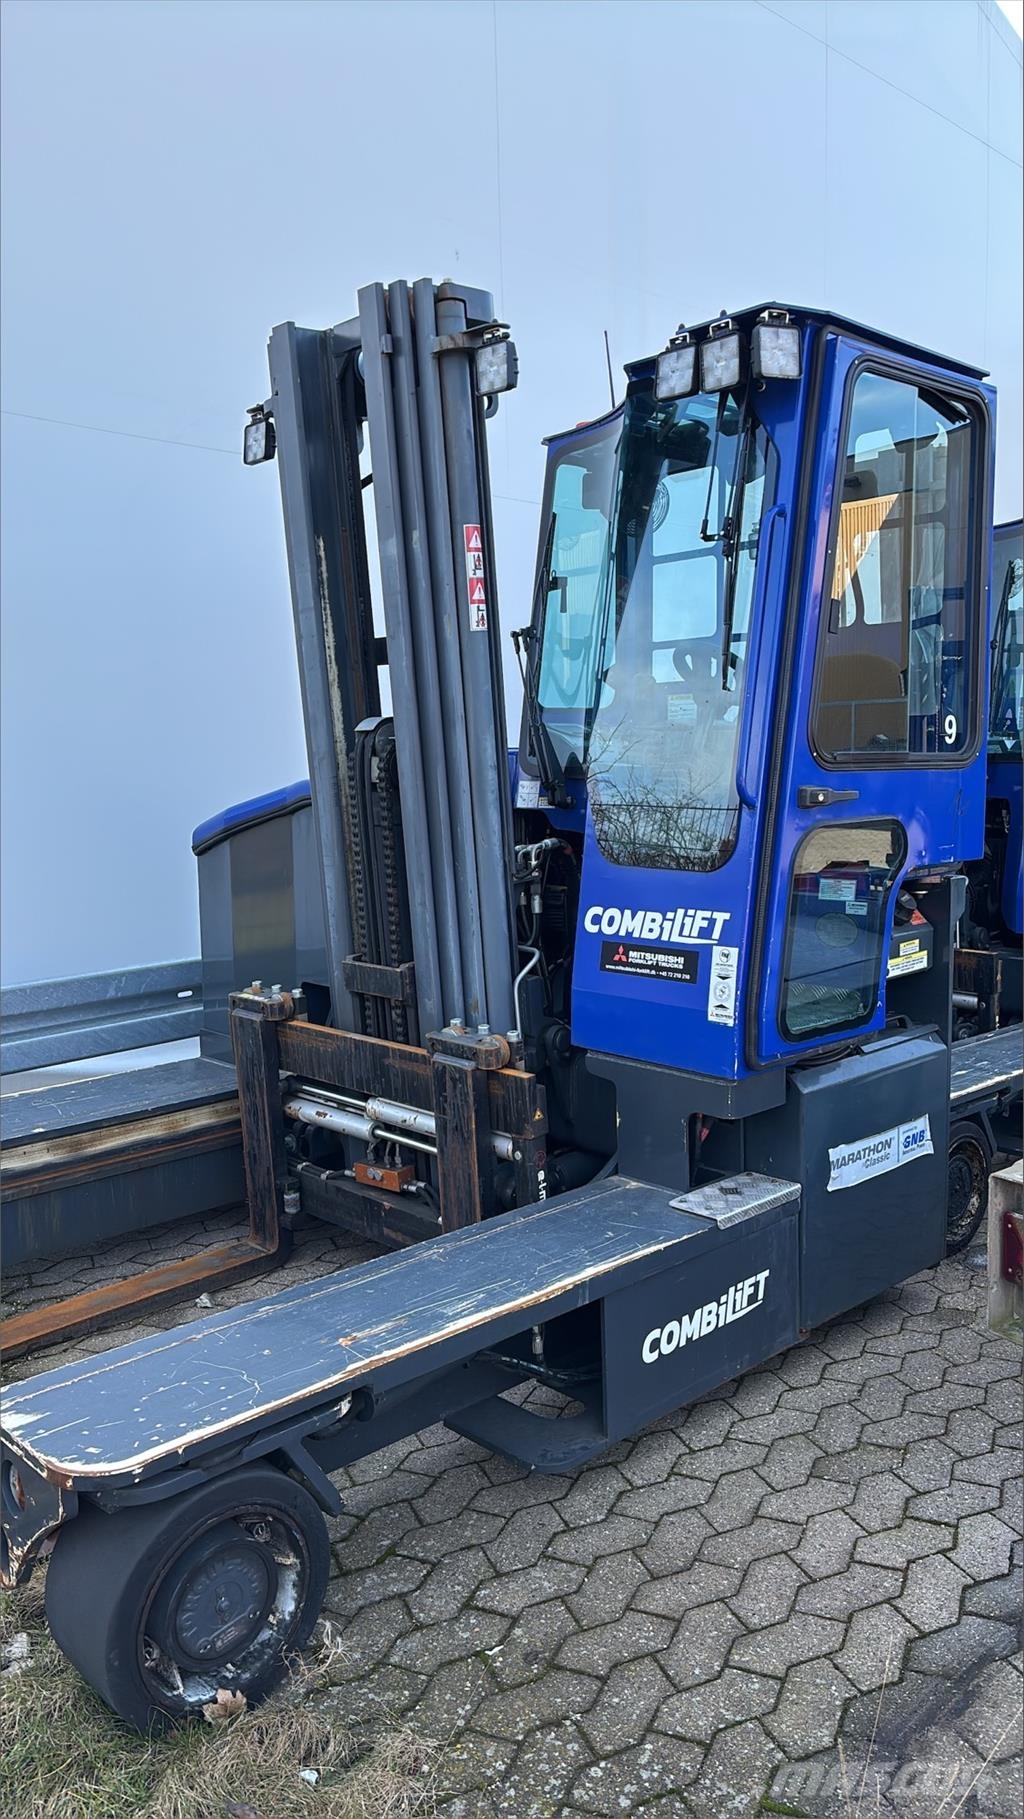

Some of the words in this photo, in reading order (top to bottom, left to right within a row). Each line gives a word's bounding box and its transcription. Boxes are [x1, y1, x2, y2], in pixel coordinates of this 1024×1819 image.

[944, 714, 957, 744] 9
[628, 950, 685, 964] MITSUBISHI
[628, 957, 656, 967] FORKLIFT
[658, 961, 684, 970] TRUCKS
[903, 1129, 926, 1149] GNB
[830, 1137, 893, 1172] MARATHON
[864, 1151, 891, 1169] Classic
